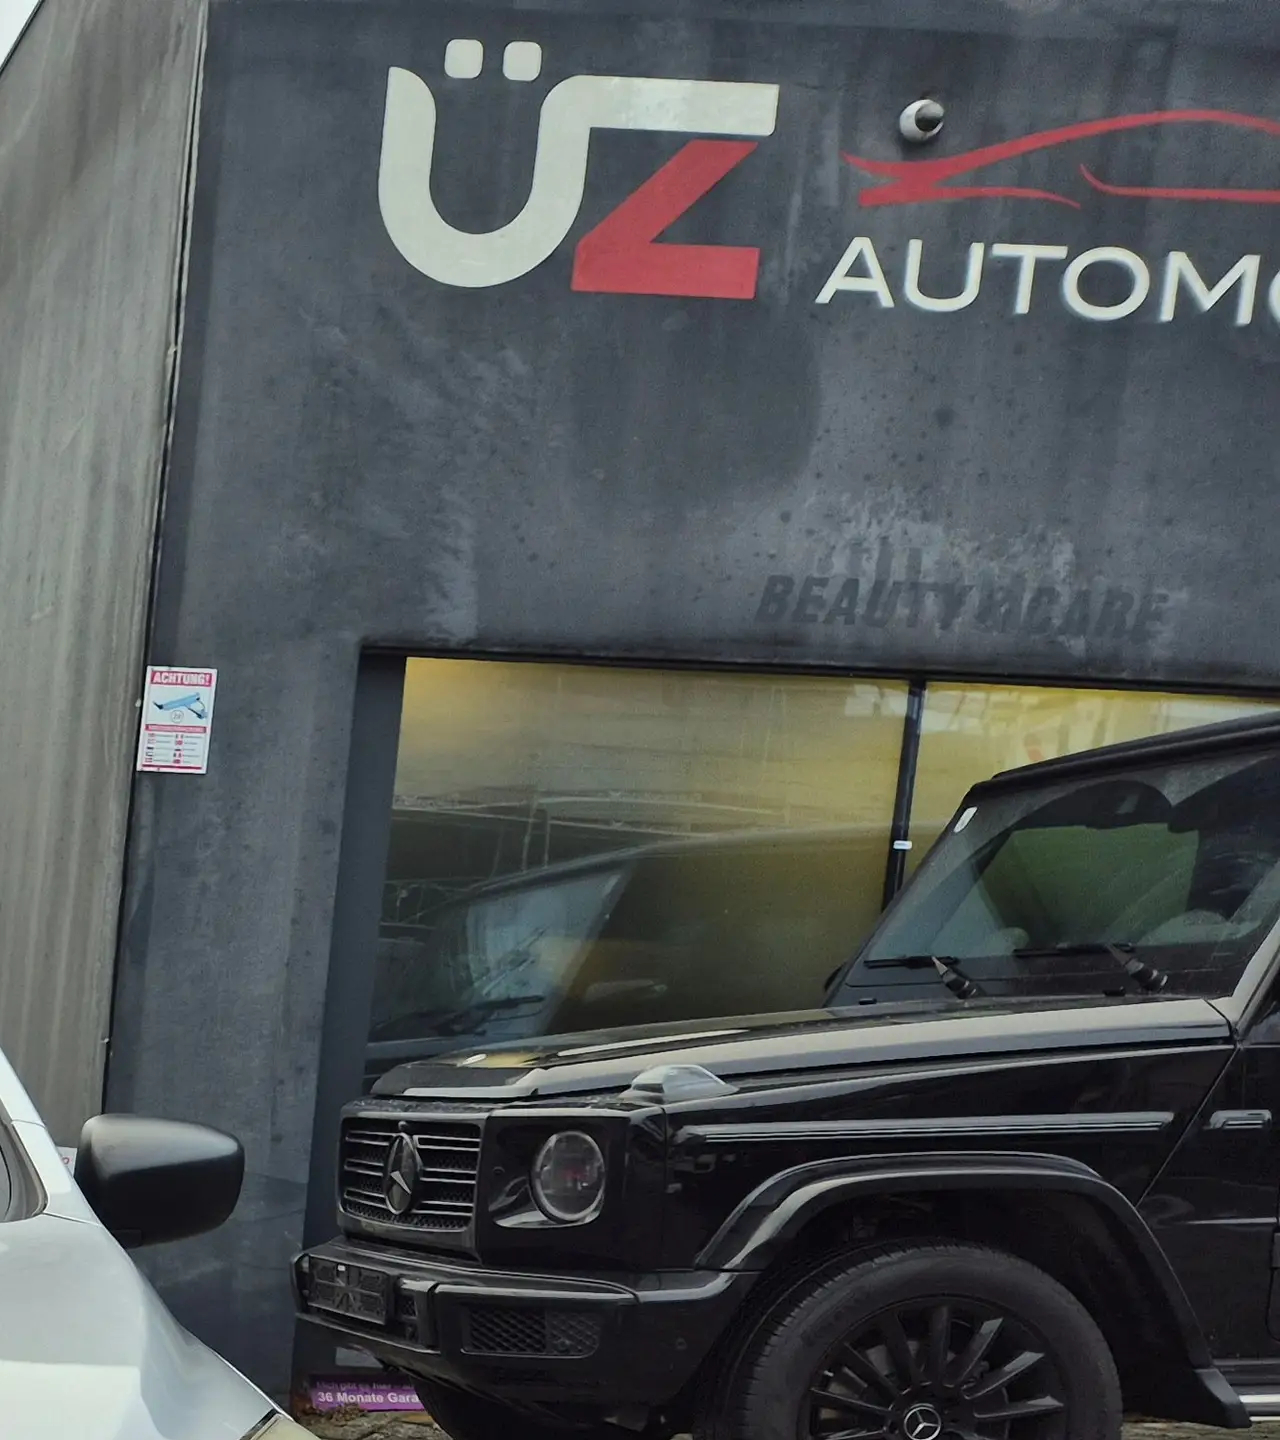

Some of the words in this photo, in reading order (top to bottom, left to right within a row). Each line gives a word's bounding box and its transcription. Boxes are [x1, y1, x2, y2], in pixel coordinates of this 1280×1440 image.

[378, 38, 780, 300] ÜZ
[815, 236, 1280, 328] AUTOM
[755, 574, 974, 630] BEAUTY
[152, 672, 210, 685] ACHTUNG!
[318, 1392, 333, 1402] 36
[336, 1391, 384, 1404] Monate
